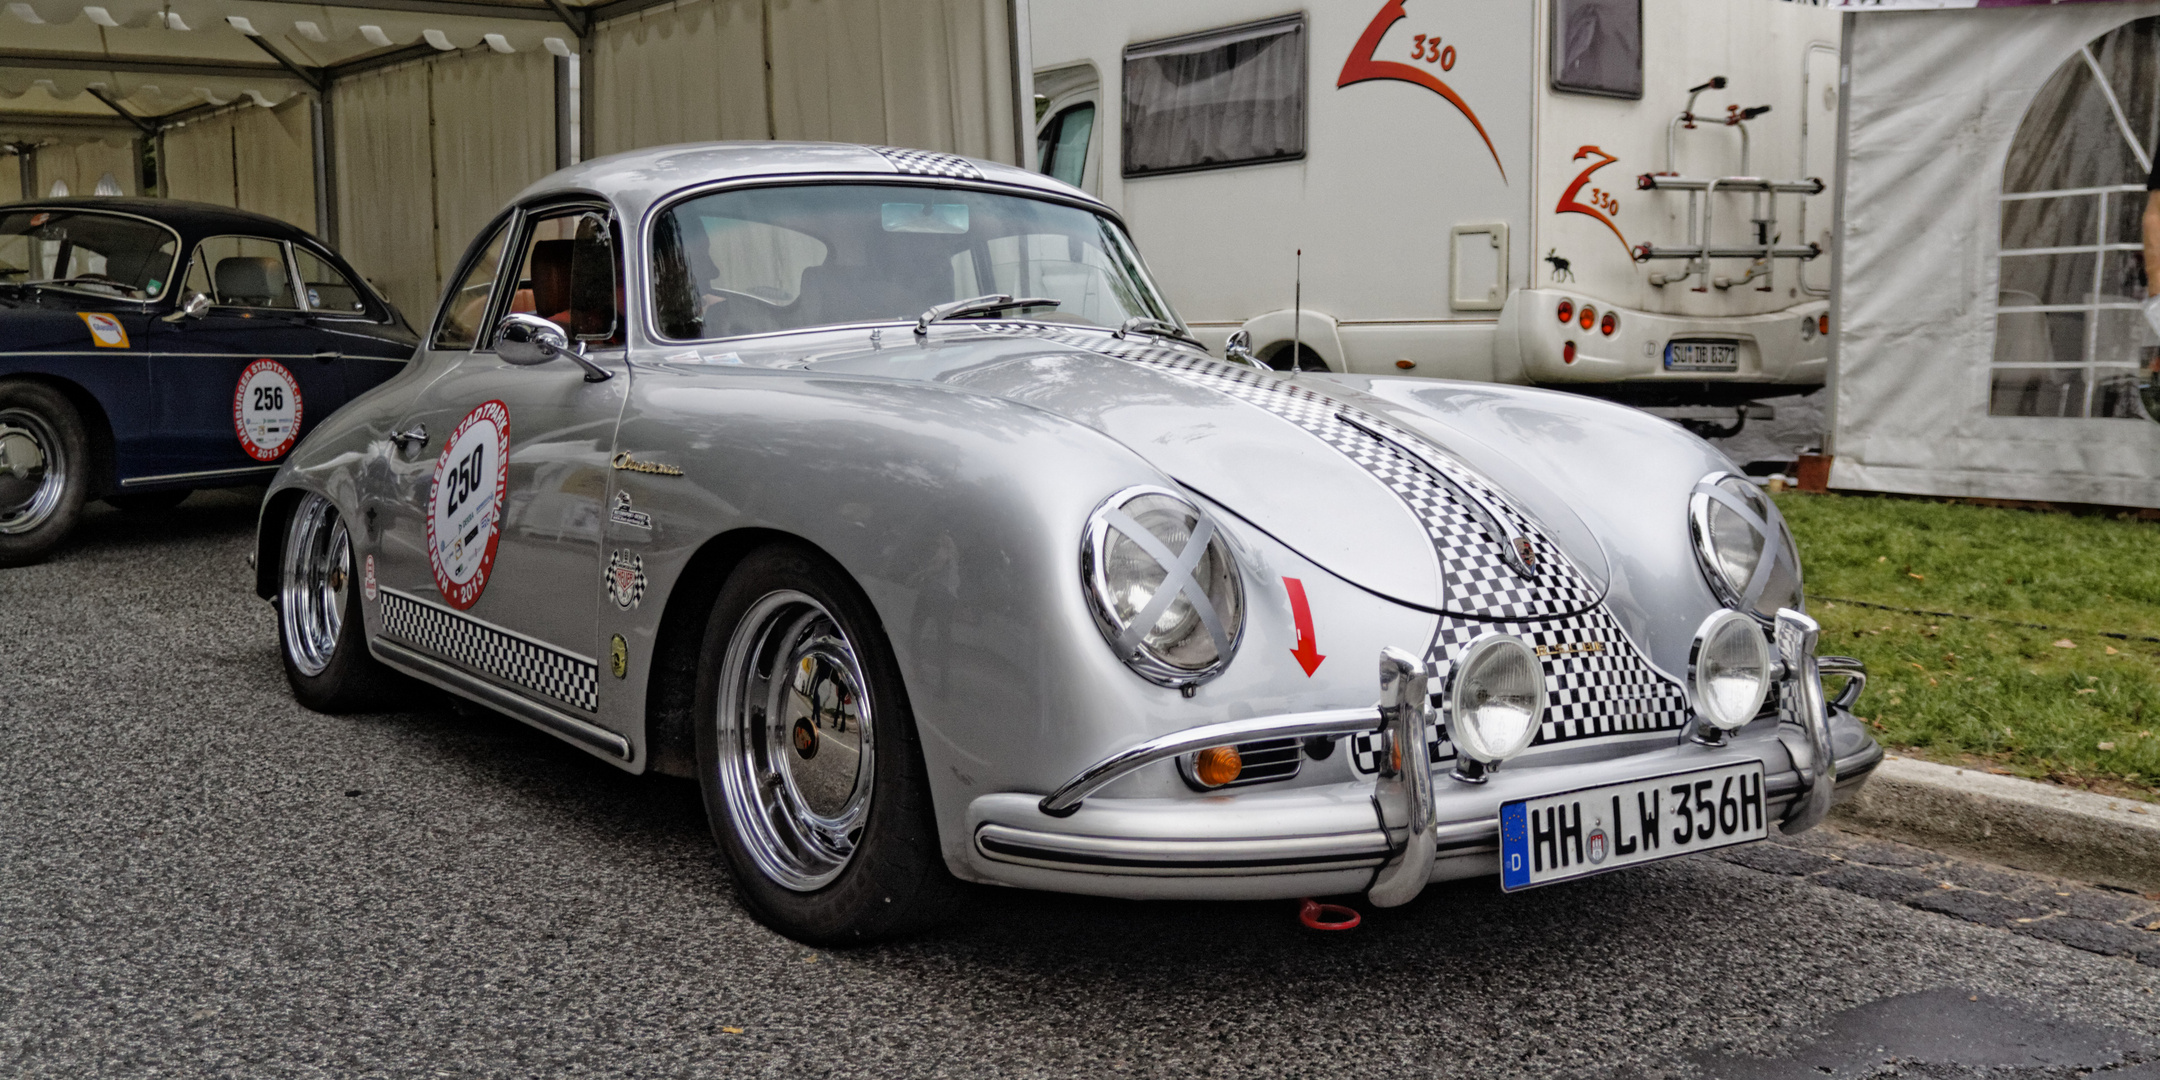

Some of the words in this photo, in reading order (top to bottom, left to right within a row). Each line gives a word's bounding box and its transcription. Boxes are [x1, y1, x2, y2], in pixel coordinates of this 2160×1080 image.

[1411, 34, 1456, 71] 330
[1591, 188, 1618, 216] 330
[1673, 346, 1687, 363] SU
[235, 371, 252, 445] HAMBURGER
[254, 387, 283, 411] 256
[257, 448, 279, 459] 2013
[447, 443, 484, 519] 250
[427, 450, 449, 594] HAMBURGER
[461, 568, 484, 604] 2013
[1536, 641, 1606, 656] RSCHE
[1531, 801, 1584, 872] HH
[1612, 788, 1659, 856] LW
[1671, 772, 1762, 845] 356H
[1511, 853, 1521, 871] D
